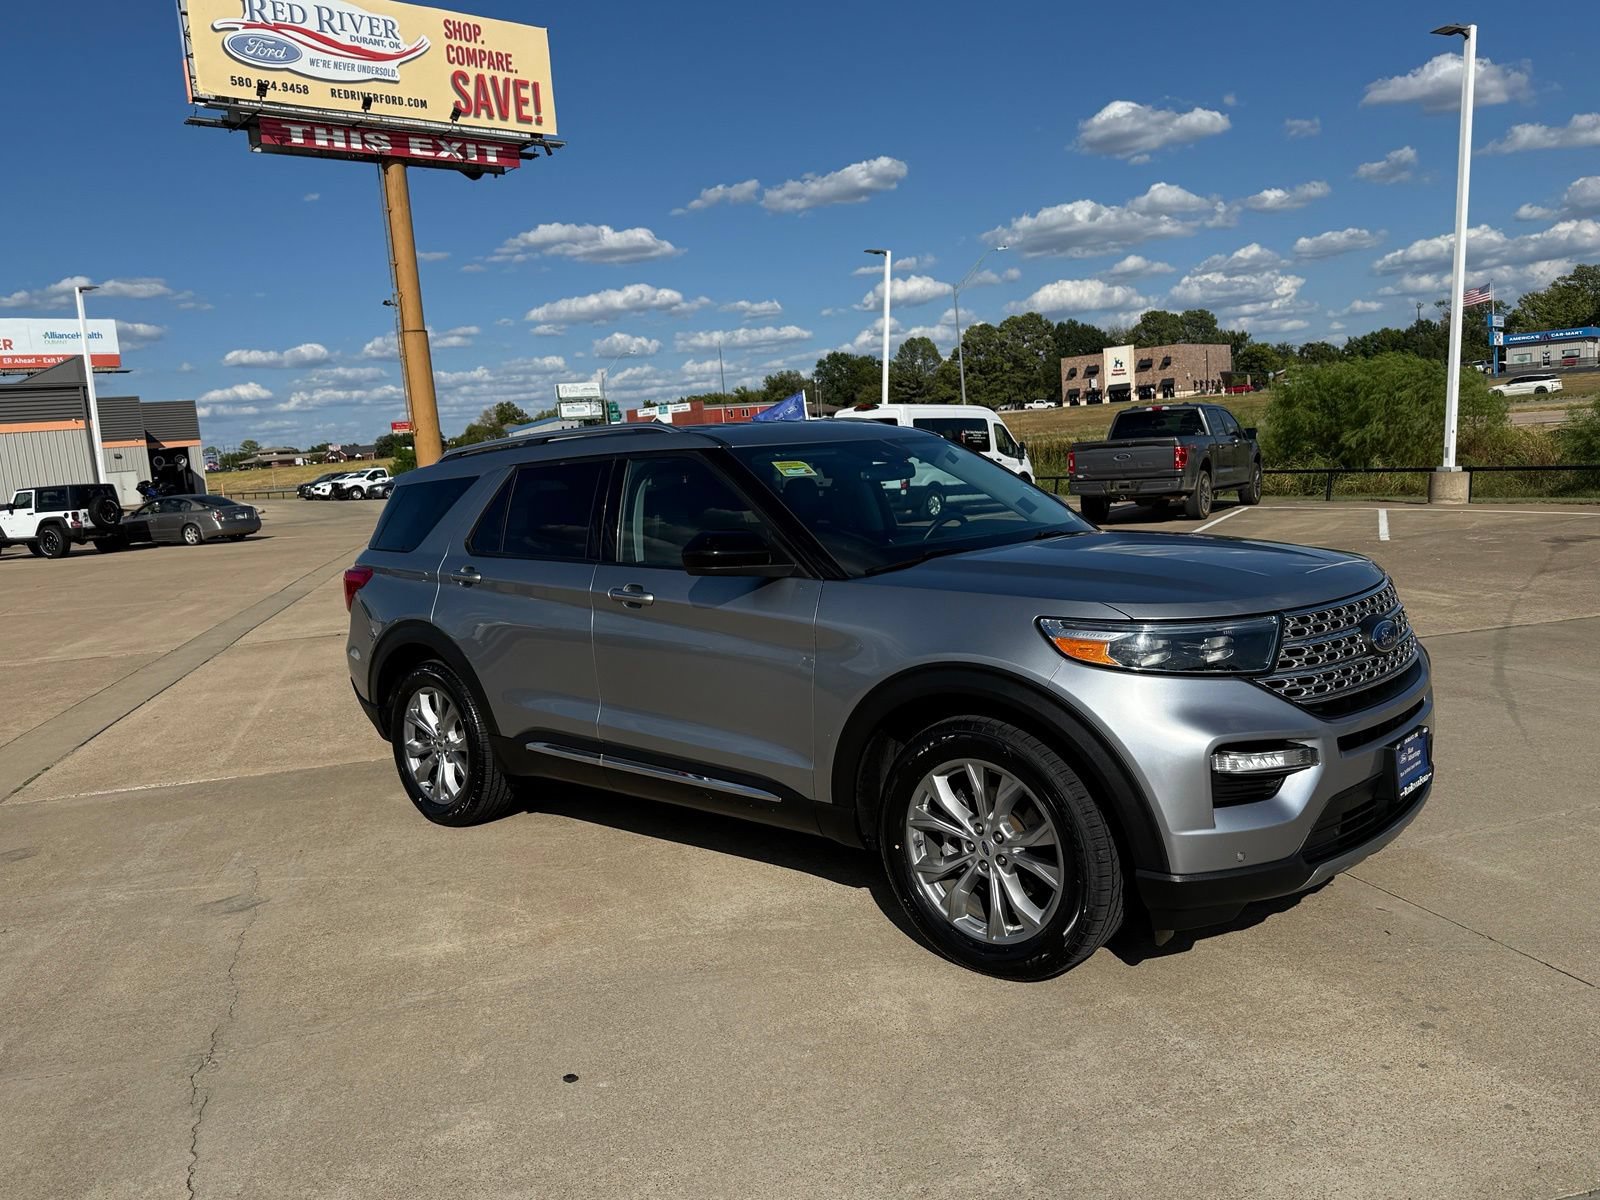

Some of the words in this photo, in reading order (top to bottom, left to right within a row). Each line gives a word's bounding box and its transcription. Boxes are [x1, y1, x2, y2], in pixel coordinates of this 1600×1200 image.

[247, 0, 307, 25] RED
[314, 4, 400, 40] RIVER
[443, 18, 485, 45] SHOP.
[244, 37, 288, 59] Ford
[350, 35, 387, 48] DURANT,
[309, 57, 333, 70] WE'RE
[333, 61, 356, 72] NEVER
[357, 64, 398, 79] UNDERSOLD.
[446, 44, 518, 74] COMPARE.
[451, 70, 543, 126] SAVE!
[281, 122, 392, 152] THIS
[408, 136, 504, 163] EXIT
[0, 339, 13, 350] R
